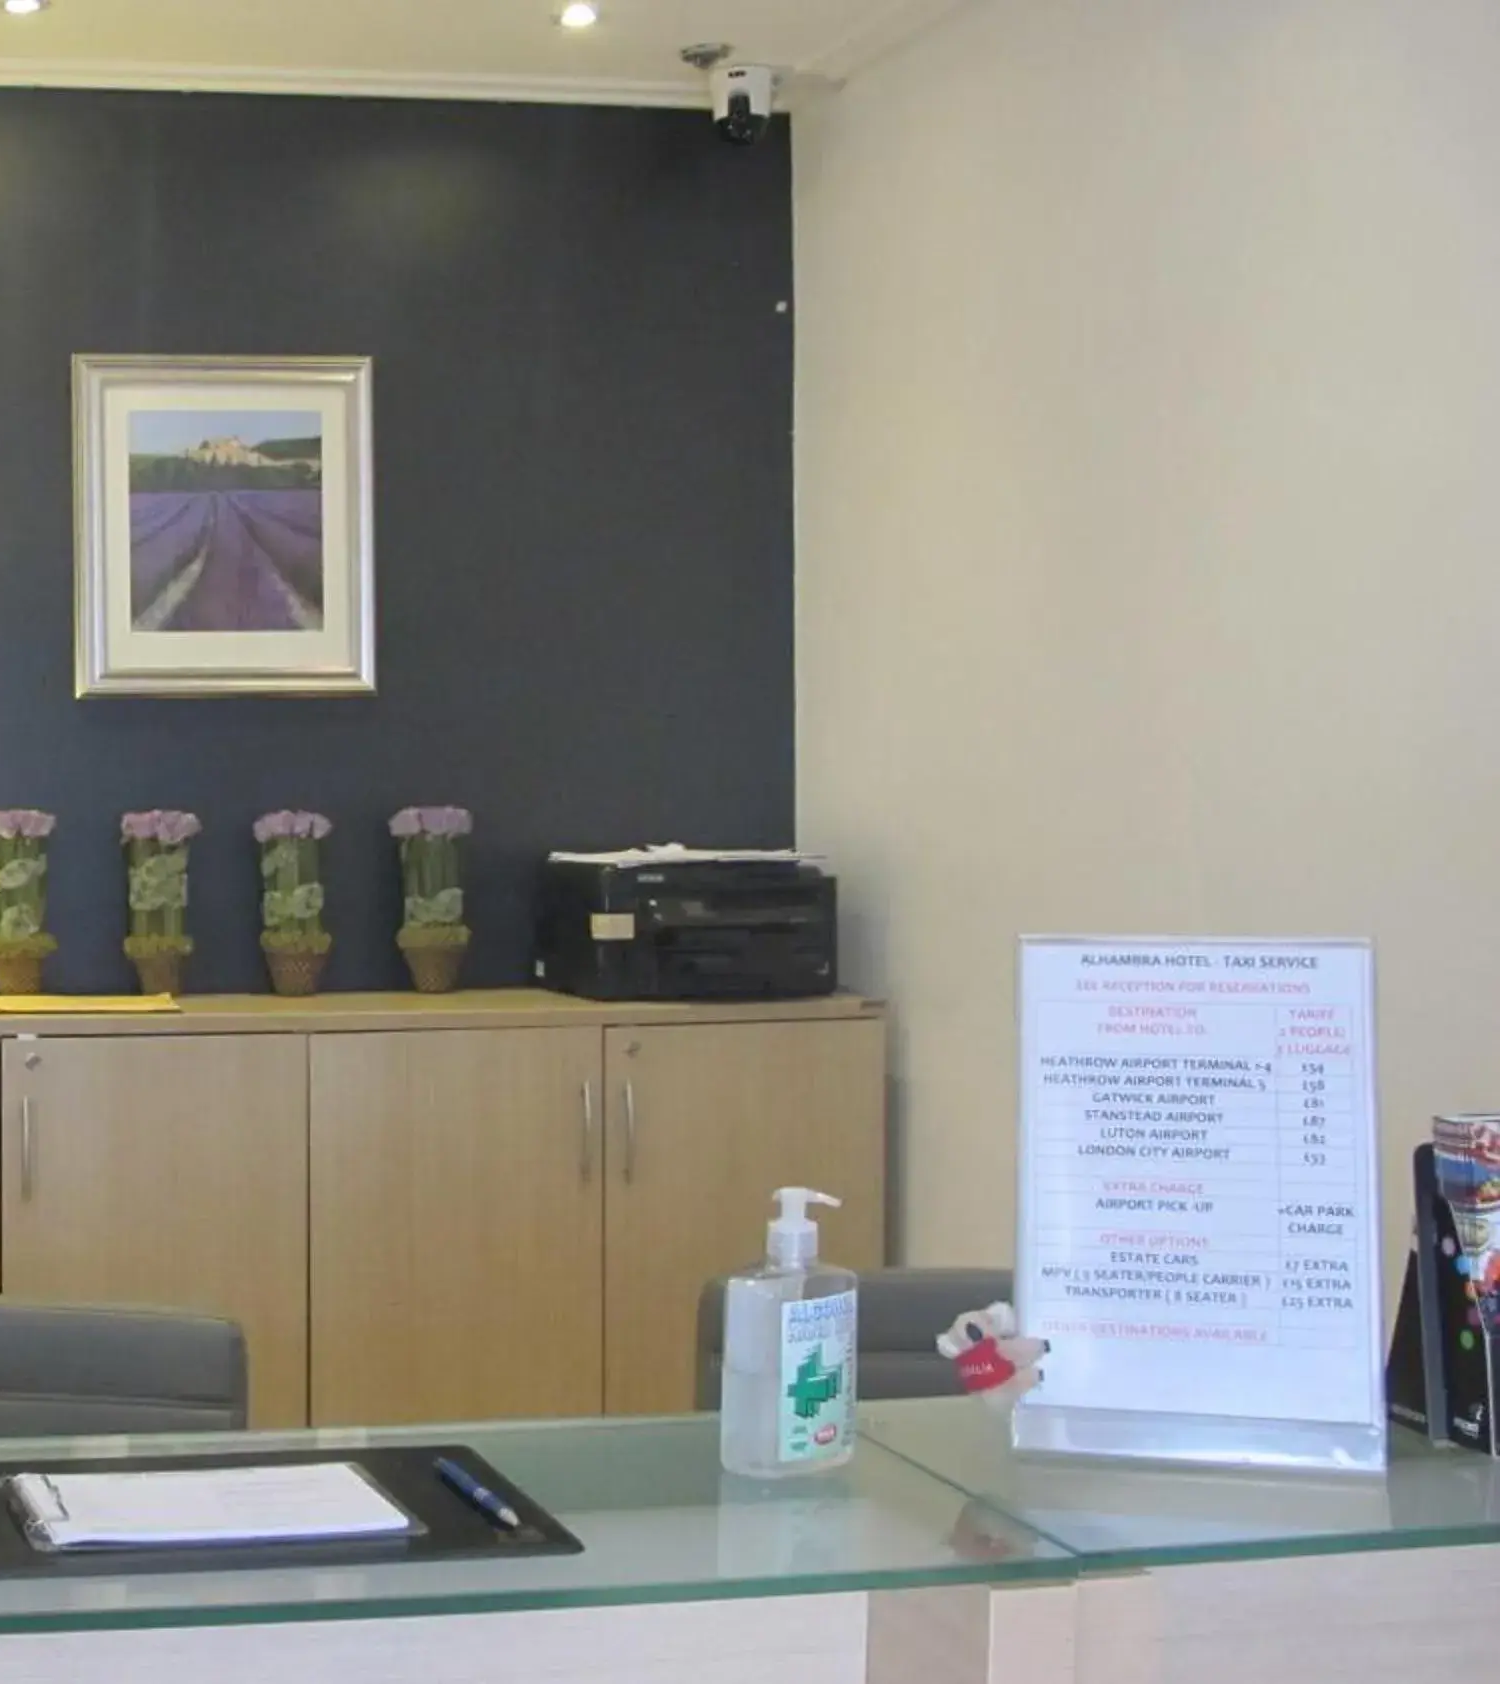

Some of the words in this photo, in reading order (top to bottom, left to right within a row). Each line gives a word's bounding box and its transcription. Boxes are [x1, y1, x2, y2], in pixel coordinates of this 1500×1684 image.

[1080, 954, 1161, 968] ALHAMBRA
[1165, 955, 1211, 968] HOTEL
[1223, 956, 1256, 968] TAXI
[1260, 957, 1318, 969] SERVICE
[1102, 981, 1174, 993] RECEPTION
[1178, 981, 1205, 993] FOR
[1209, 982, 1311, 995] RESERVATIONS
[1107, 1006, 1197, 1018] DESTINATION
[1288, 1009, 1334, 1021] TARIFF
[1097, 1024, 1135, 1035] FROM
[1139, 1025, 1181, 1036] HOTEL
[1040, 1056, 1117, 1069] HEATHROW
[1121, 1058, 1178, 1070] AIRPORT
[1183, 1059, 1251, 1072] TERMINAL
[1043, 1073, 1120, 1086] HEATHROW
[1125, 1075, 1181, 1088] AIRPORT
[1186, 1076, 1255, 1089] TERMINAL
[1091, 1092, 1154, 1105] GATWICK
[1157, 1093, 1216, 1106] AIRPORT
[1084, 1109, 1162, 1123] STANSTEAD
[1165, 1110, 1224, 1125] AIRPORT
[1100, 1127, 1146, 1141] LUTON
[1149, 1128, 1208, 1142] AIRPORT
[1077, 1144, 1136, 1157] LONDON
[1139, 1145, 1169, 1159] CITY
[1171, 1146, 1230, 1161] AIRPORT
[1102, 1181, 1147, 1194] EXTRA
[1150, 1182, 1205, 1196] CHARGE
[1095, 1198, 1152, 1212] AIRPORT
[1157, 1199, 1188, 1213] PICK
[1317, 1206, 1355, 1219] PARK
[1287, 1222, 1344, 1236] CHARGE
[1099, 1233, 1145, 1246] OTHER
[1148, 1235, 1209, 1250] OPTIONS
[1110, 1251, 1161, 1265] ESTATE
[1163, 1253, 1199, 1267] CARS
[1303, 1260, 1349, 1273] EXTRA
[1202, 1272, 1262, 1288] CARRIER
[1306, 1278, 1352, 1292] EXTRA
[1065, 1285, 1162, 1301] TRANSPORTER
[1185, 1291, 1238, 1304] SEATER
[1307, 1296, 1354, 1310] EXTRA
[1090, 1320, 1192, 1339] DESTINATIONS
[1194, 1326, 1268, 1342] AVAILABLE
